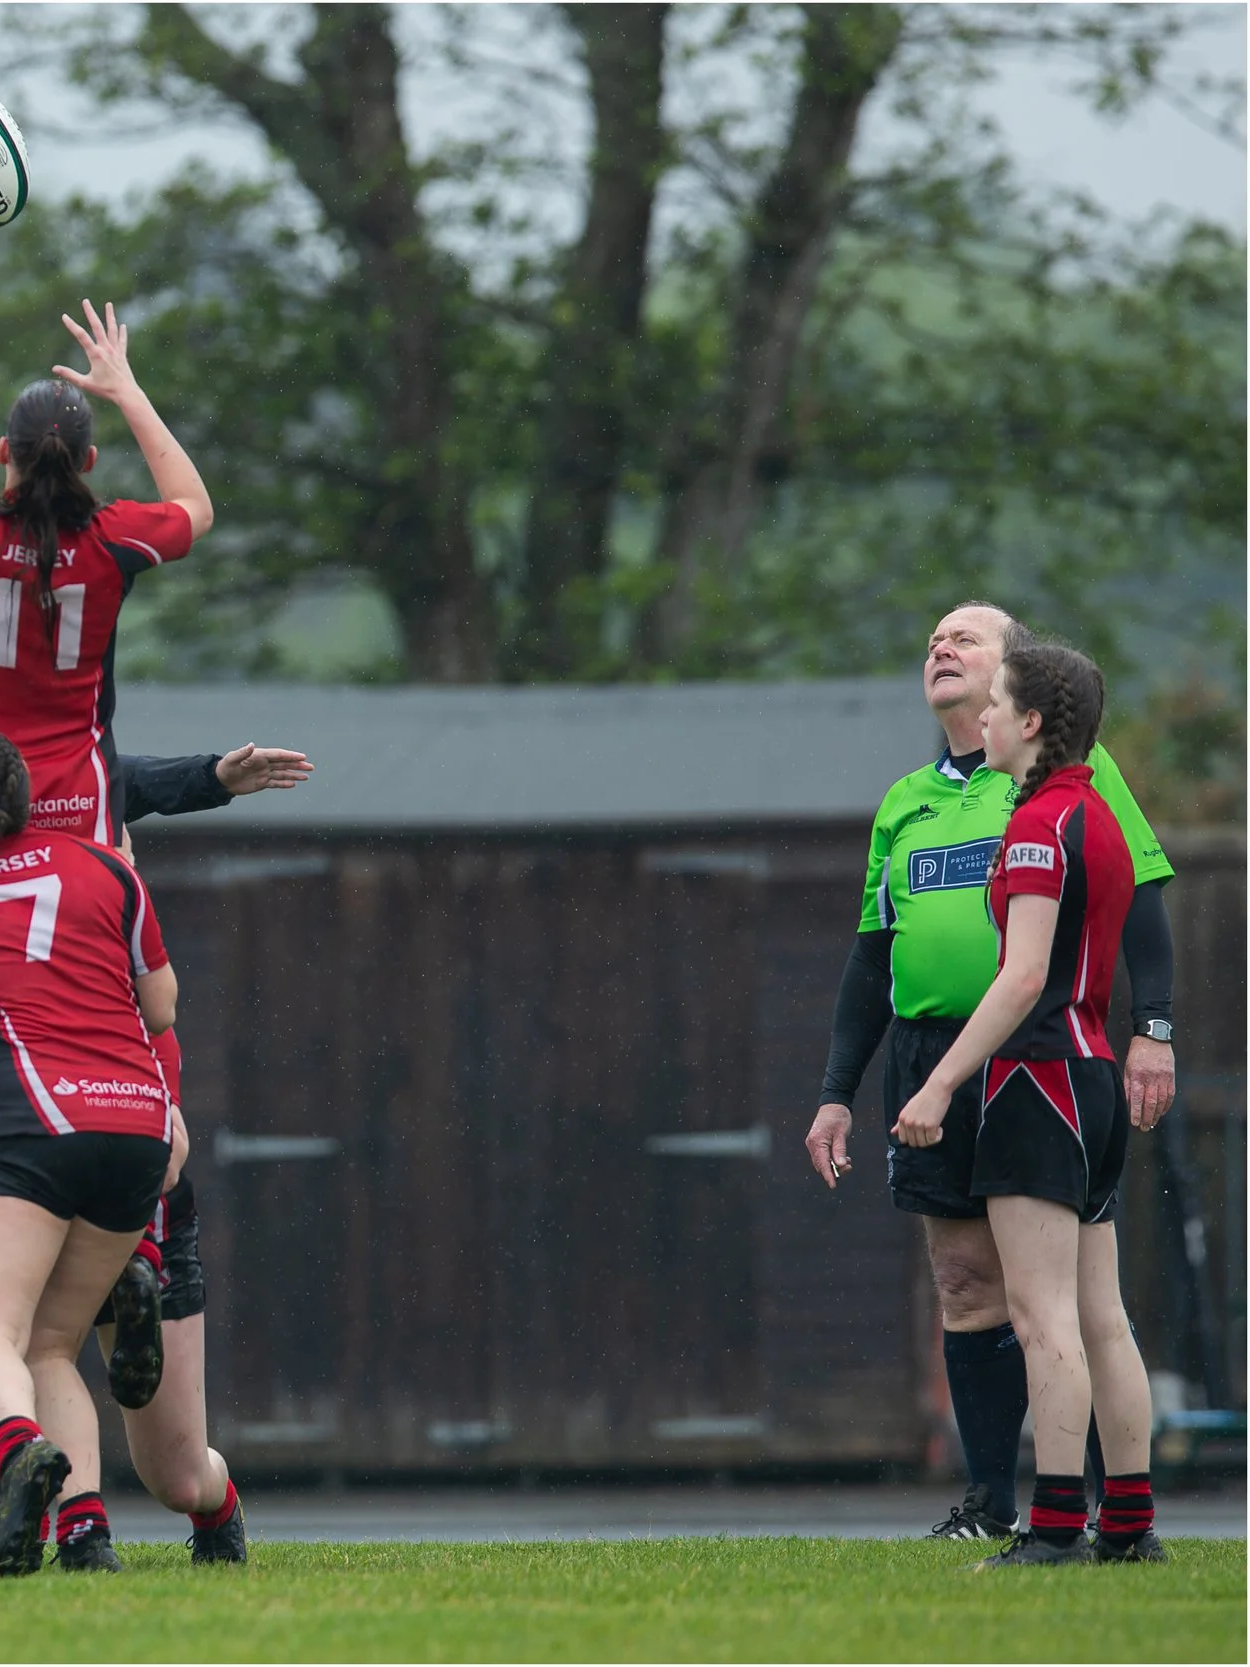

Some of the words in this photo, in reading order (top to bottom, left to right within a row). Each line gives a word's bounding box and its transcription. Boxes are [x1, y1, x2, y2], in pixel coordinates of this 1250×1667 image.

[950, 852, 986, 864] PROTECT
[78, 1079, 163, 1100] Santander
[85, 1096, 155, 1112] International
